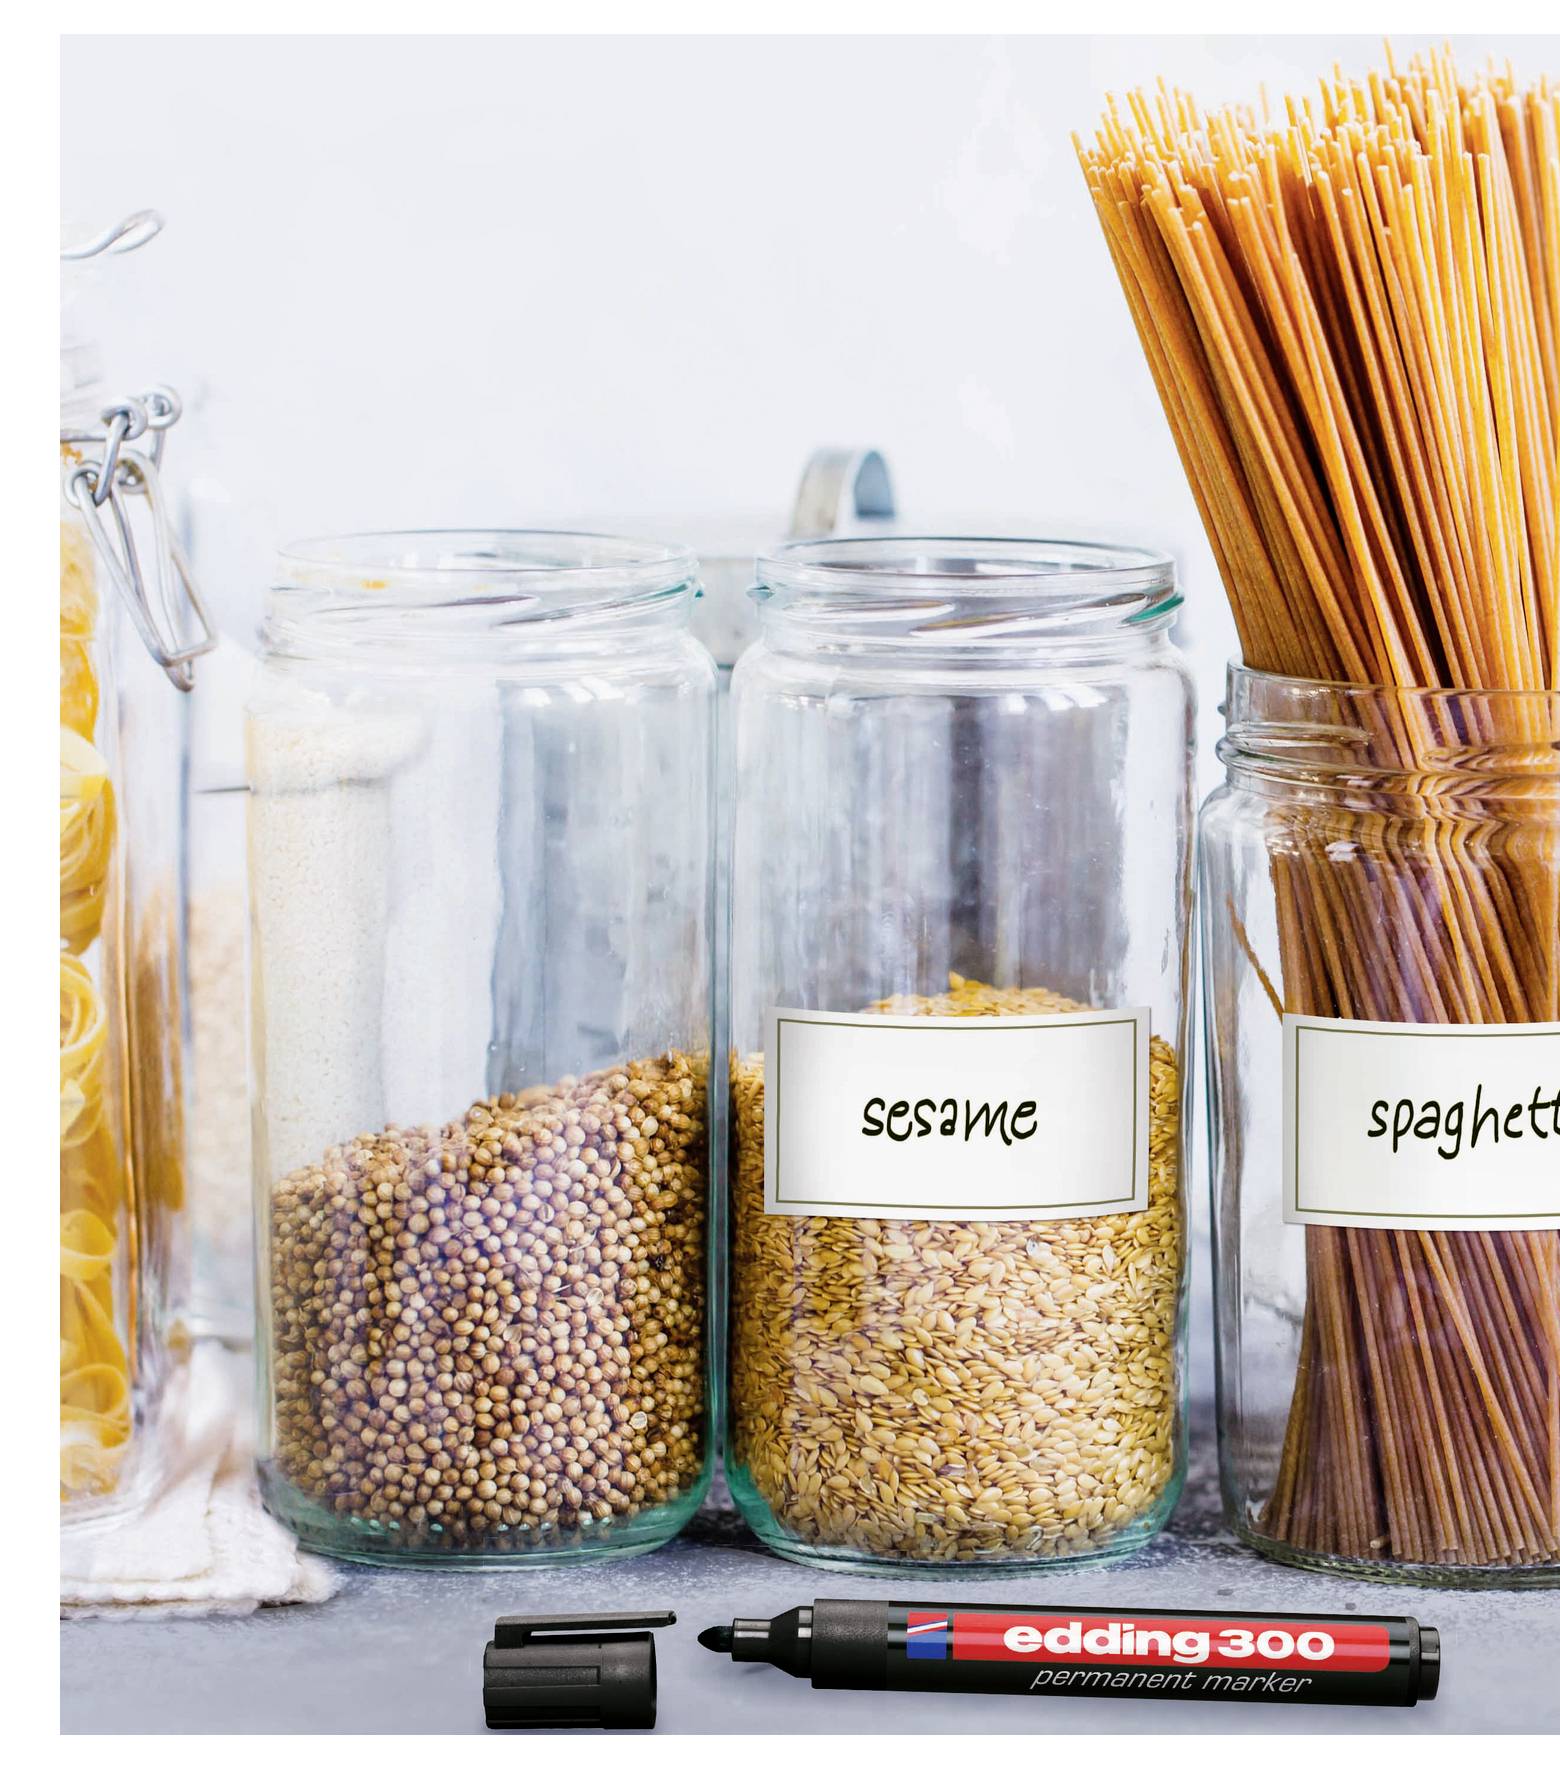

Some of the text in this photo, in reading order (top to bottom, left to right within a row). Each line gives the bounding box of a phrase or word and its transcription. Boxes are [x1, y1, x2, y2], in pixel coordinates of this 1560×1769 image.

[861, 1097, 1038, 1146] sesame
[1003, 1621, 1335, 1663] edding 300
[1030, 1668, 1313, 1693] permanent marker
